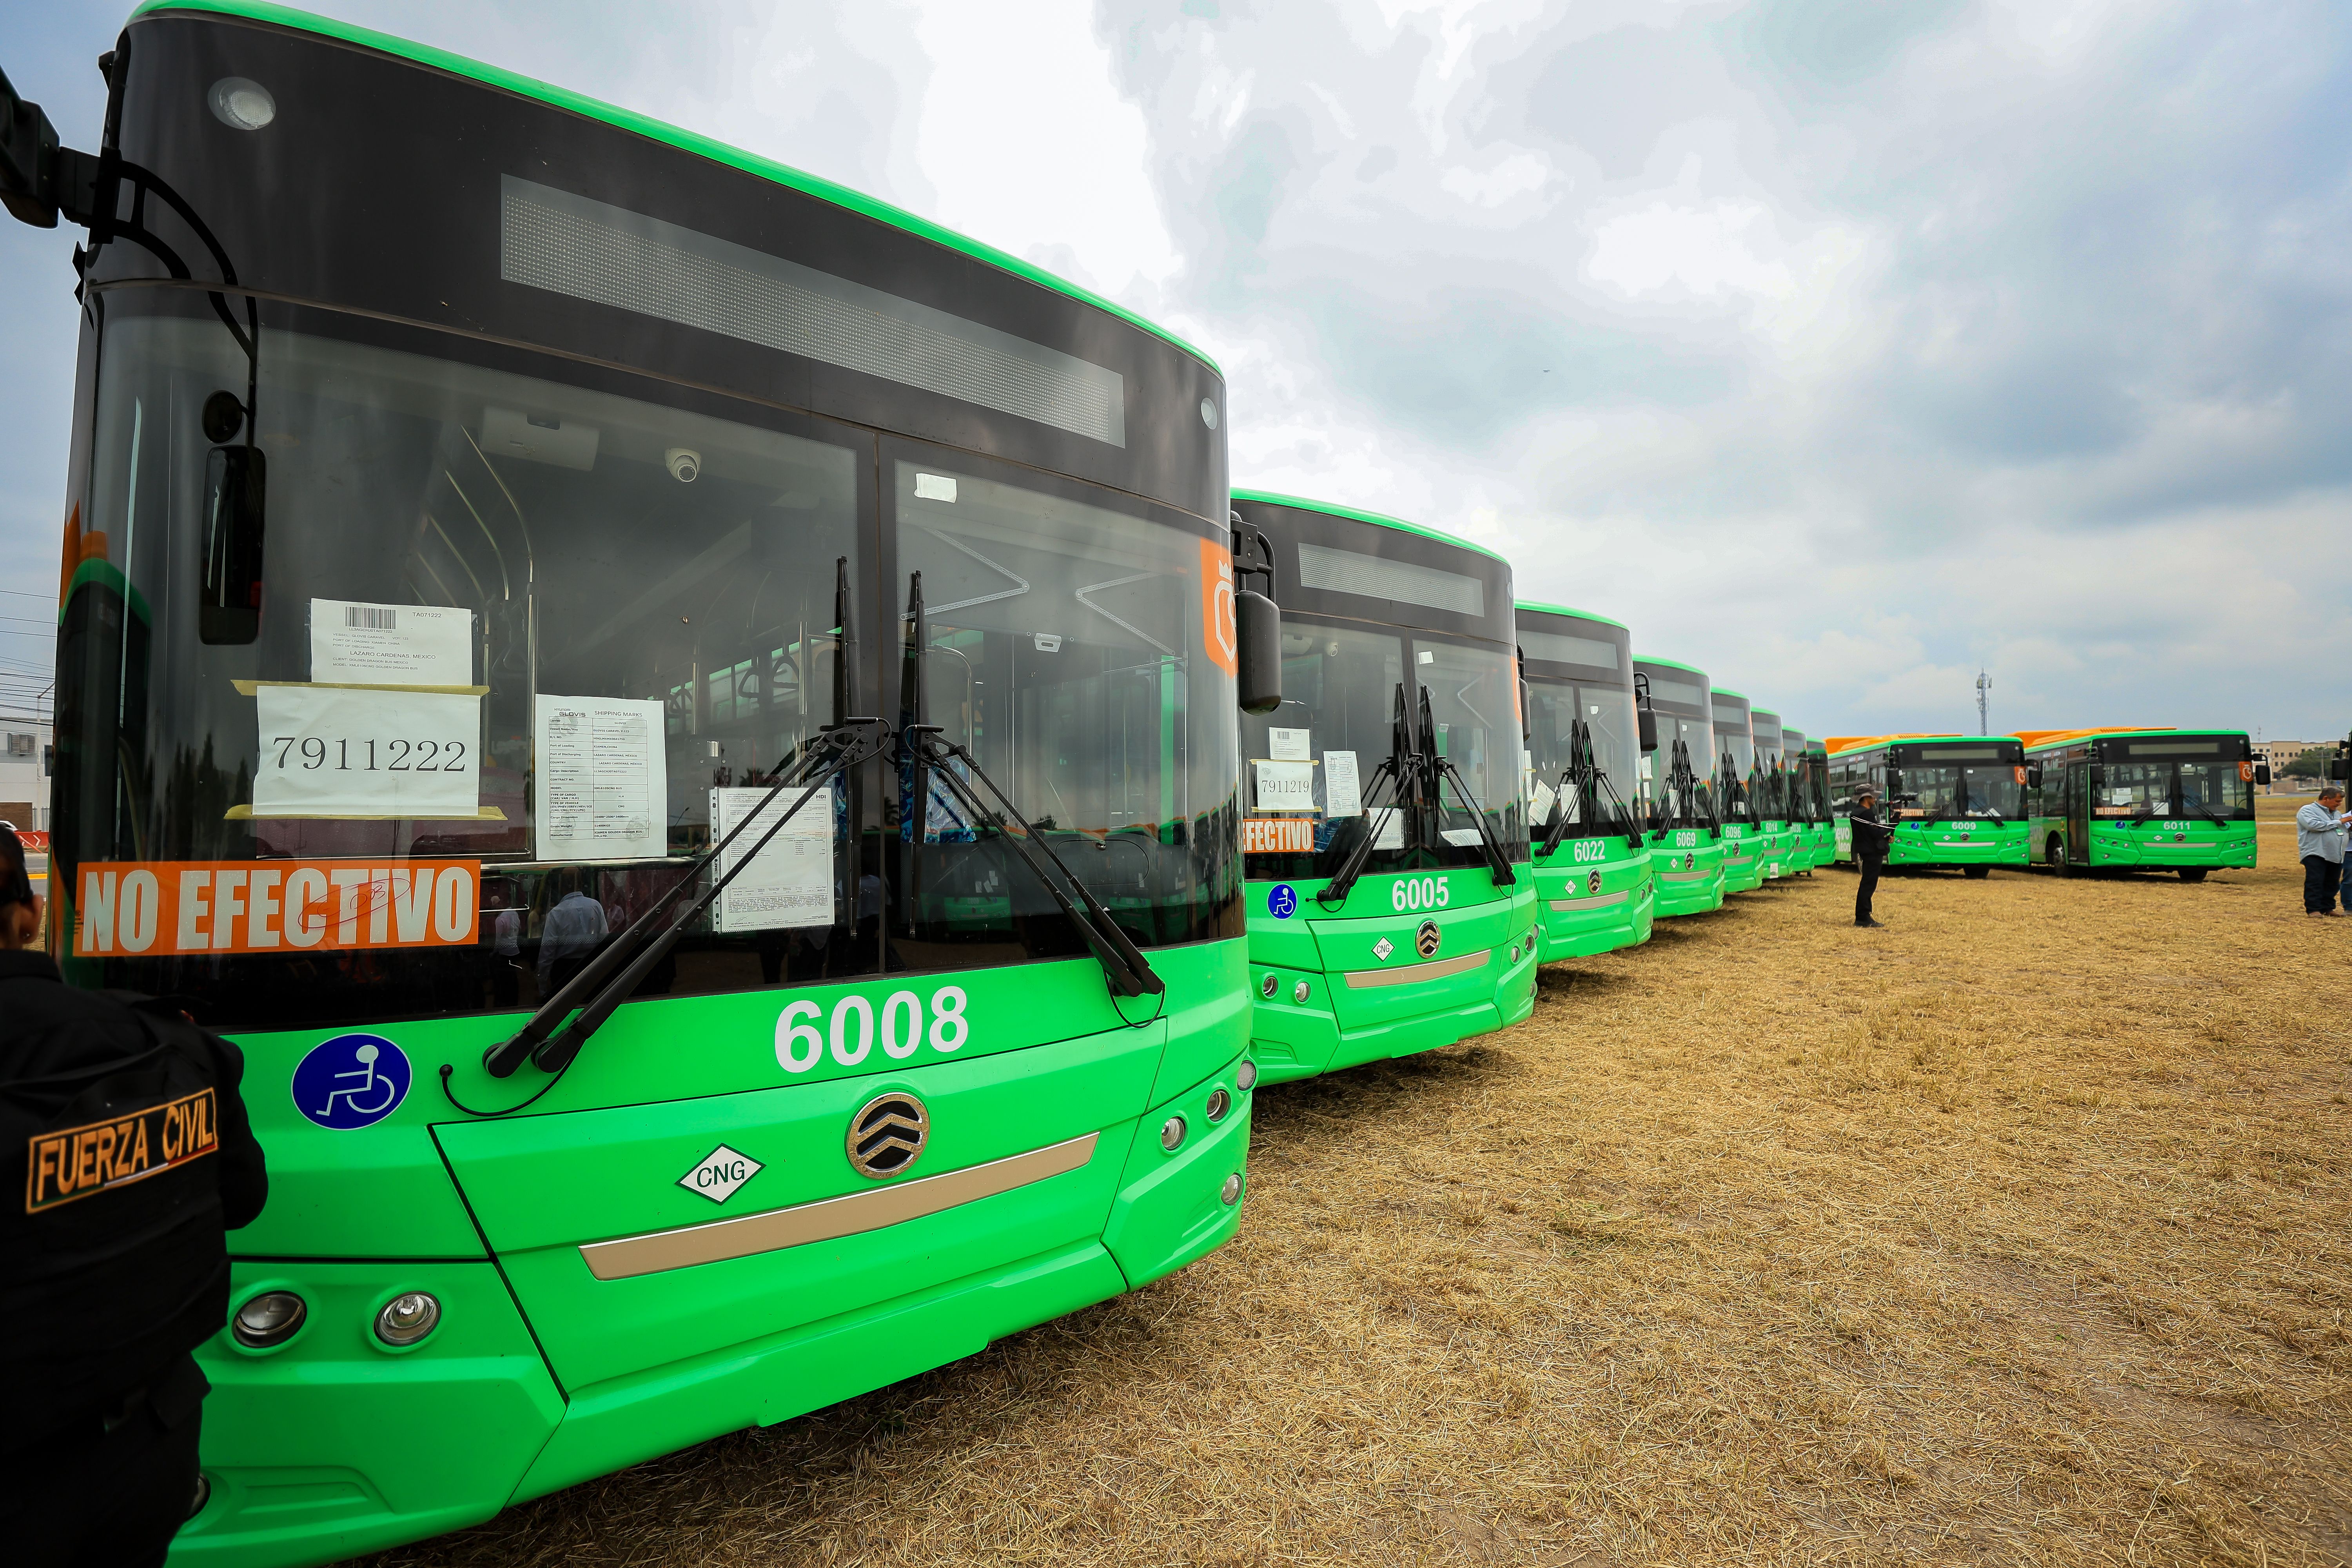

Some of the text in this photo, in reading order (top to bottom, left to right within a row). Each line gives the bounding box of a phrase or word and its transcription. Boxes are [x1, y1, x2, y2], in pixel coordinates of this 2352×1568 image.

[272, 737, 466, 772] 7911222
[1262, 780, 1309, 792] 7911219
[1726, 826, 1741, 838] 6096
[1766, 822, 1777, 833] 6014
[2163, 822, 2190, 830] 6011
[1677, 832, 1696, 847] 6069
[1574, 840, 1605, 862] 6022
[1392, 877, 1449, 911] 6005
[82, 867, 474, 951] NO EFECTIVO
[1377, 944, 1390, 953] CNG
[775, 986, 968, 1073] 6008
[36, 1098, 213, 1201] FUERZA CIVIL
[697, 1160, 746, 1188] CNG
